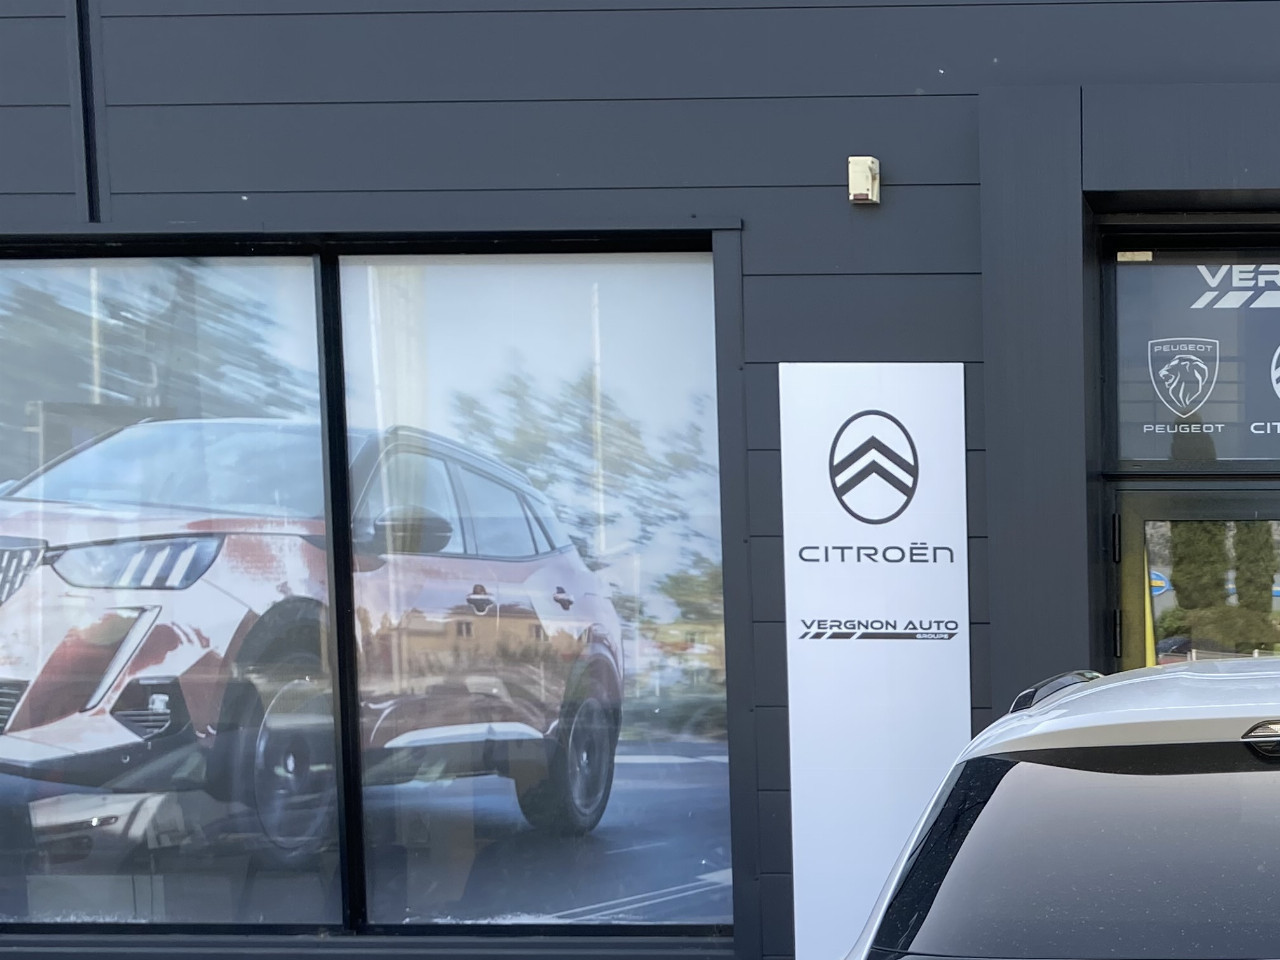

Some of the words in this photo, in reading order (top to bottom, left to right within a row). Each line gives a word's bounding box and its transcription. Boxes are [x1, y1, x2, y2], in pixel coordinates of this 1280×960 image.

[1153, 343, 1214, 352] PEUGEOT
[1143, 423, 1226, 434] PEUGEOT
[800, 619, 897, 631] VERGNON
[903, 619, 959, 631] AUTO
